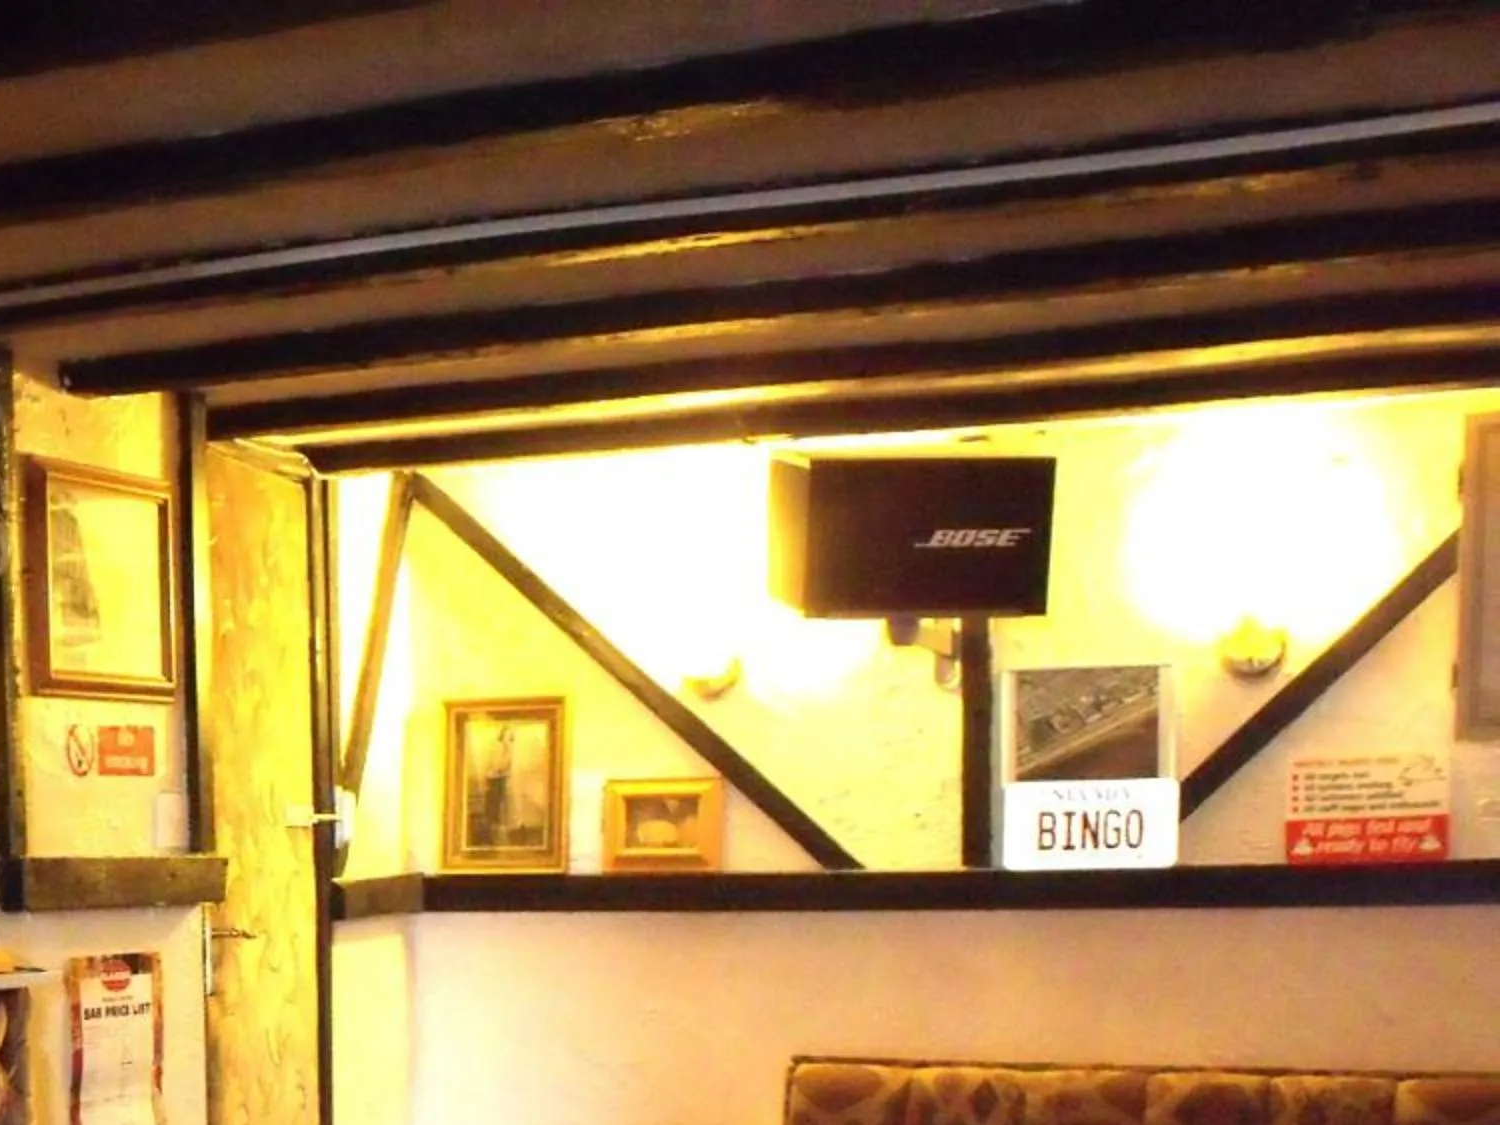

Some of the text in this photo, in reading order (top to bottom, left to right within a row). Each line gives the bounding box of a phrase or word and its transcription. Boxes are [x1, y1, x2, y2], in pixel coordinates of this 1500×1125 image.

[914, 528, 1031, 548] BOSE
[1038, 808, 1144, 851] BINGO
[83, 1007, 102, 1021] BAR
[105, 1004, 130, 1018] PRICE
